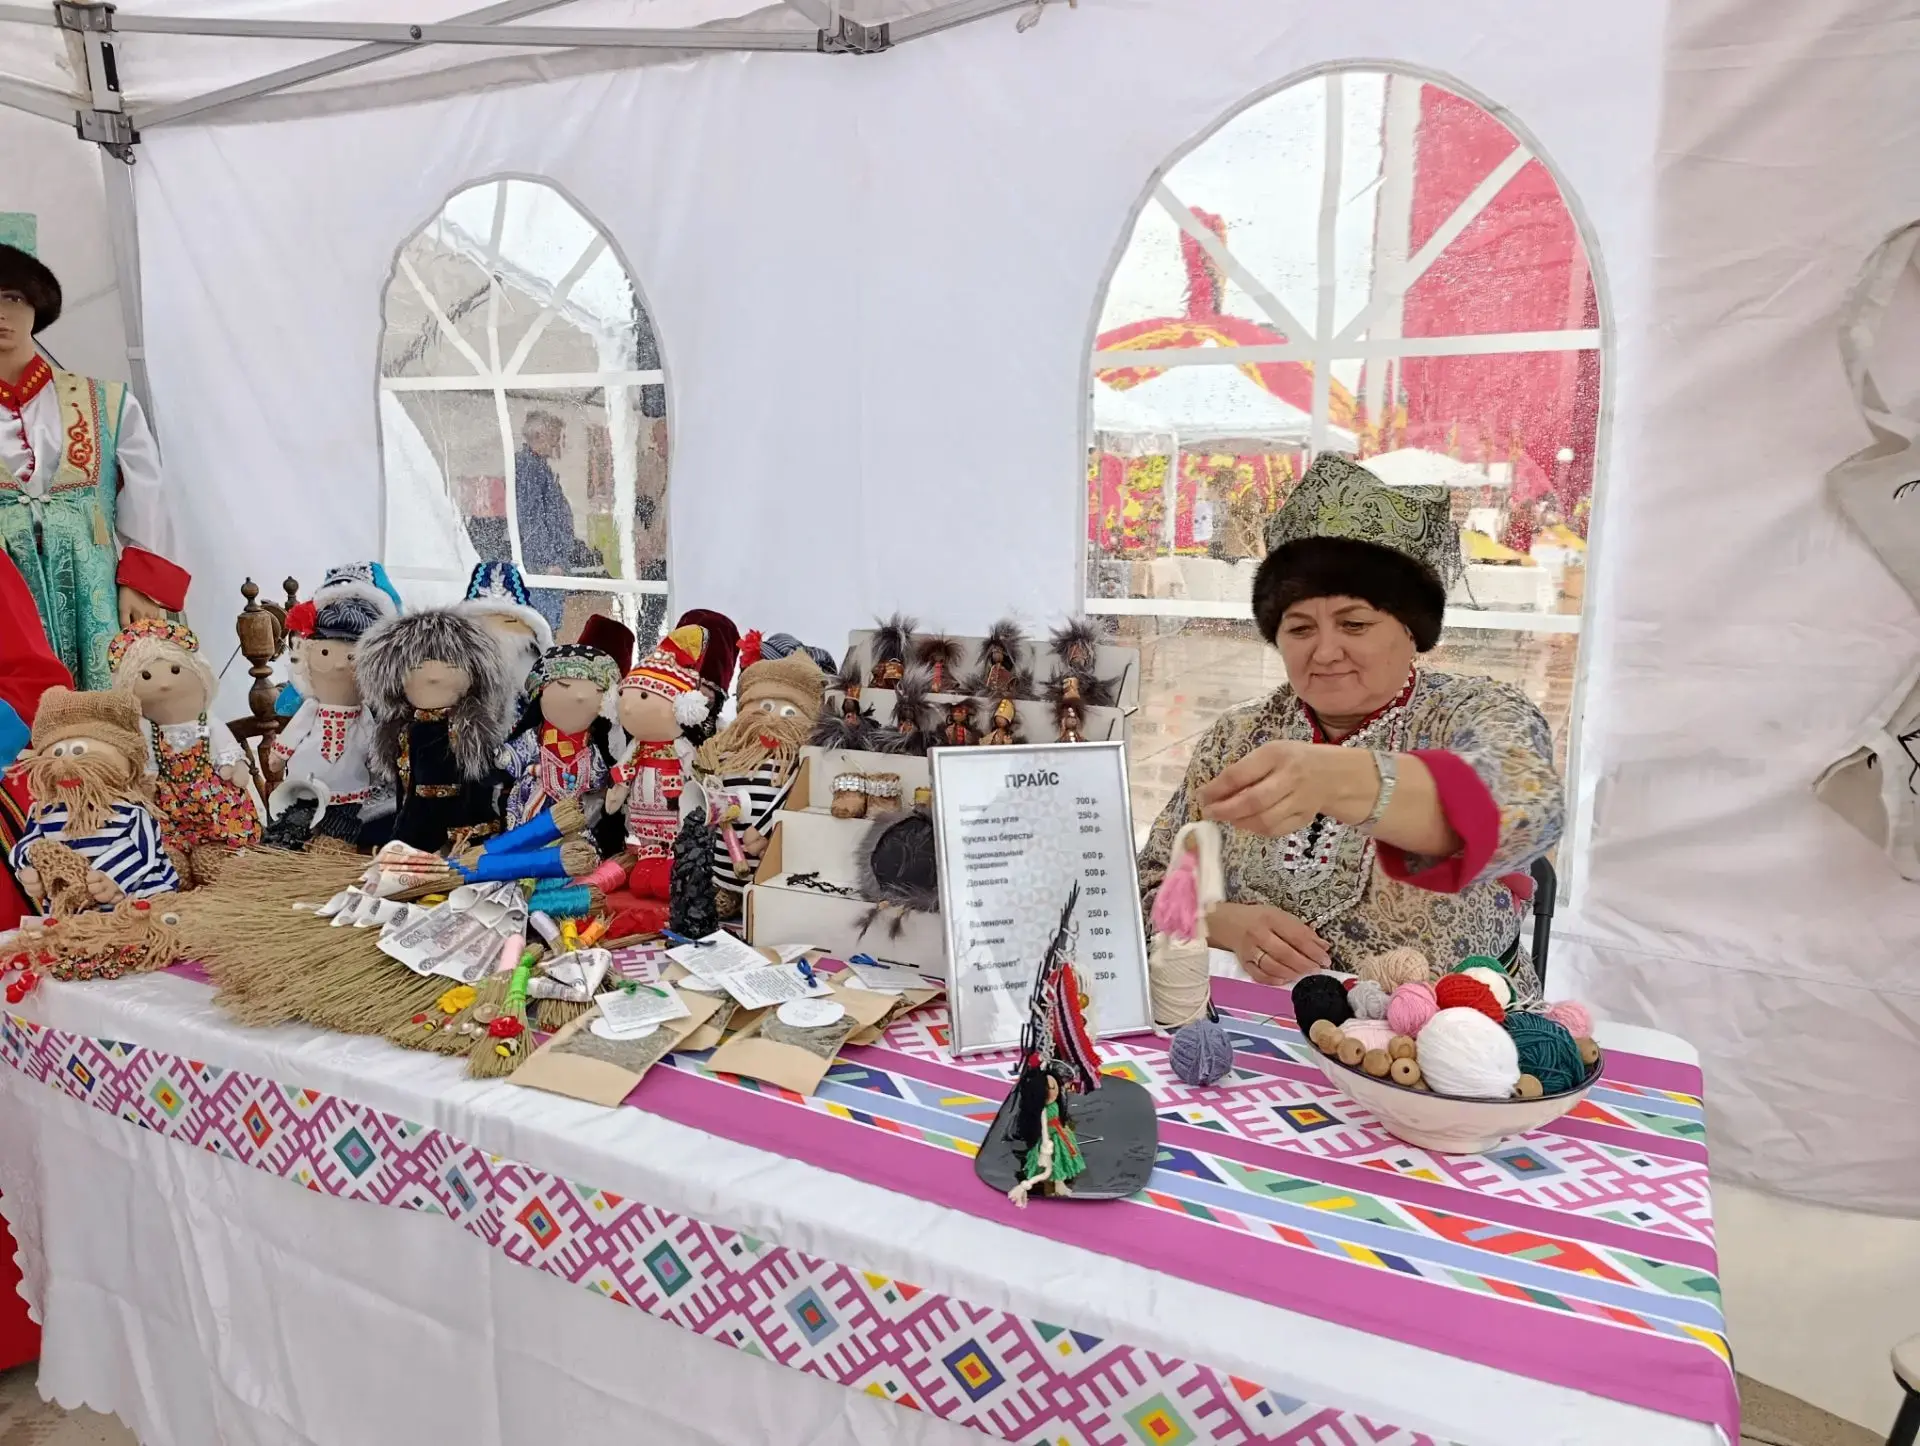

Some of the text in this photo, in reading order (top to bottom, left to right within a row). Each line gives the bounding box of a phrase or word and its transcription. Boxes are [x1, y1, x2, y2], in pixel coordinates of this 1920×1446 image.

[1004, 769, 1059, 788] ПРАЙС
[1076, 797, 1090, 805] 700
[1077, 811, 1092, 820] 250
[1002, 815, 1019, 826] угля
[1079, 825, 1094, 833] 500
[962, 836, 986, 845] Кукла
[999, 832, 1034, 842] бересты
[963, 850, 1024, 860] Национальные
[1082, 851, 1097, 860] 600
[965, 861, 1008, 872] украшения
[1084, 868, 1099, 876] 500
[1085, 886, 1100, 895] 250
[1087, 909, 1102, 917] 250
[1090, 927, 1103, 935] 100
[1092, 951, 1107, 960] 500
[1095, 971, 1109, 980] 250
[973, 984, 998, 995] Кукла
